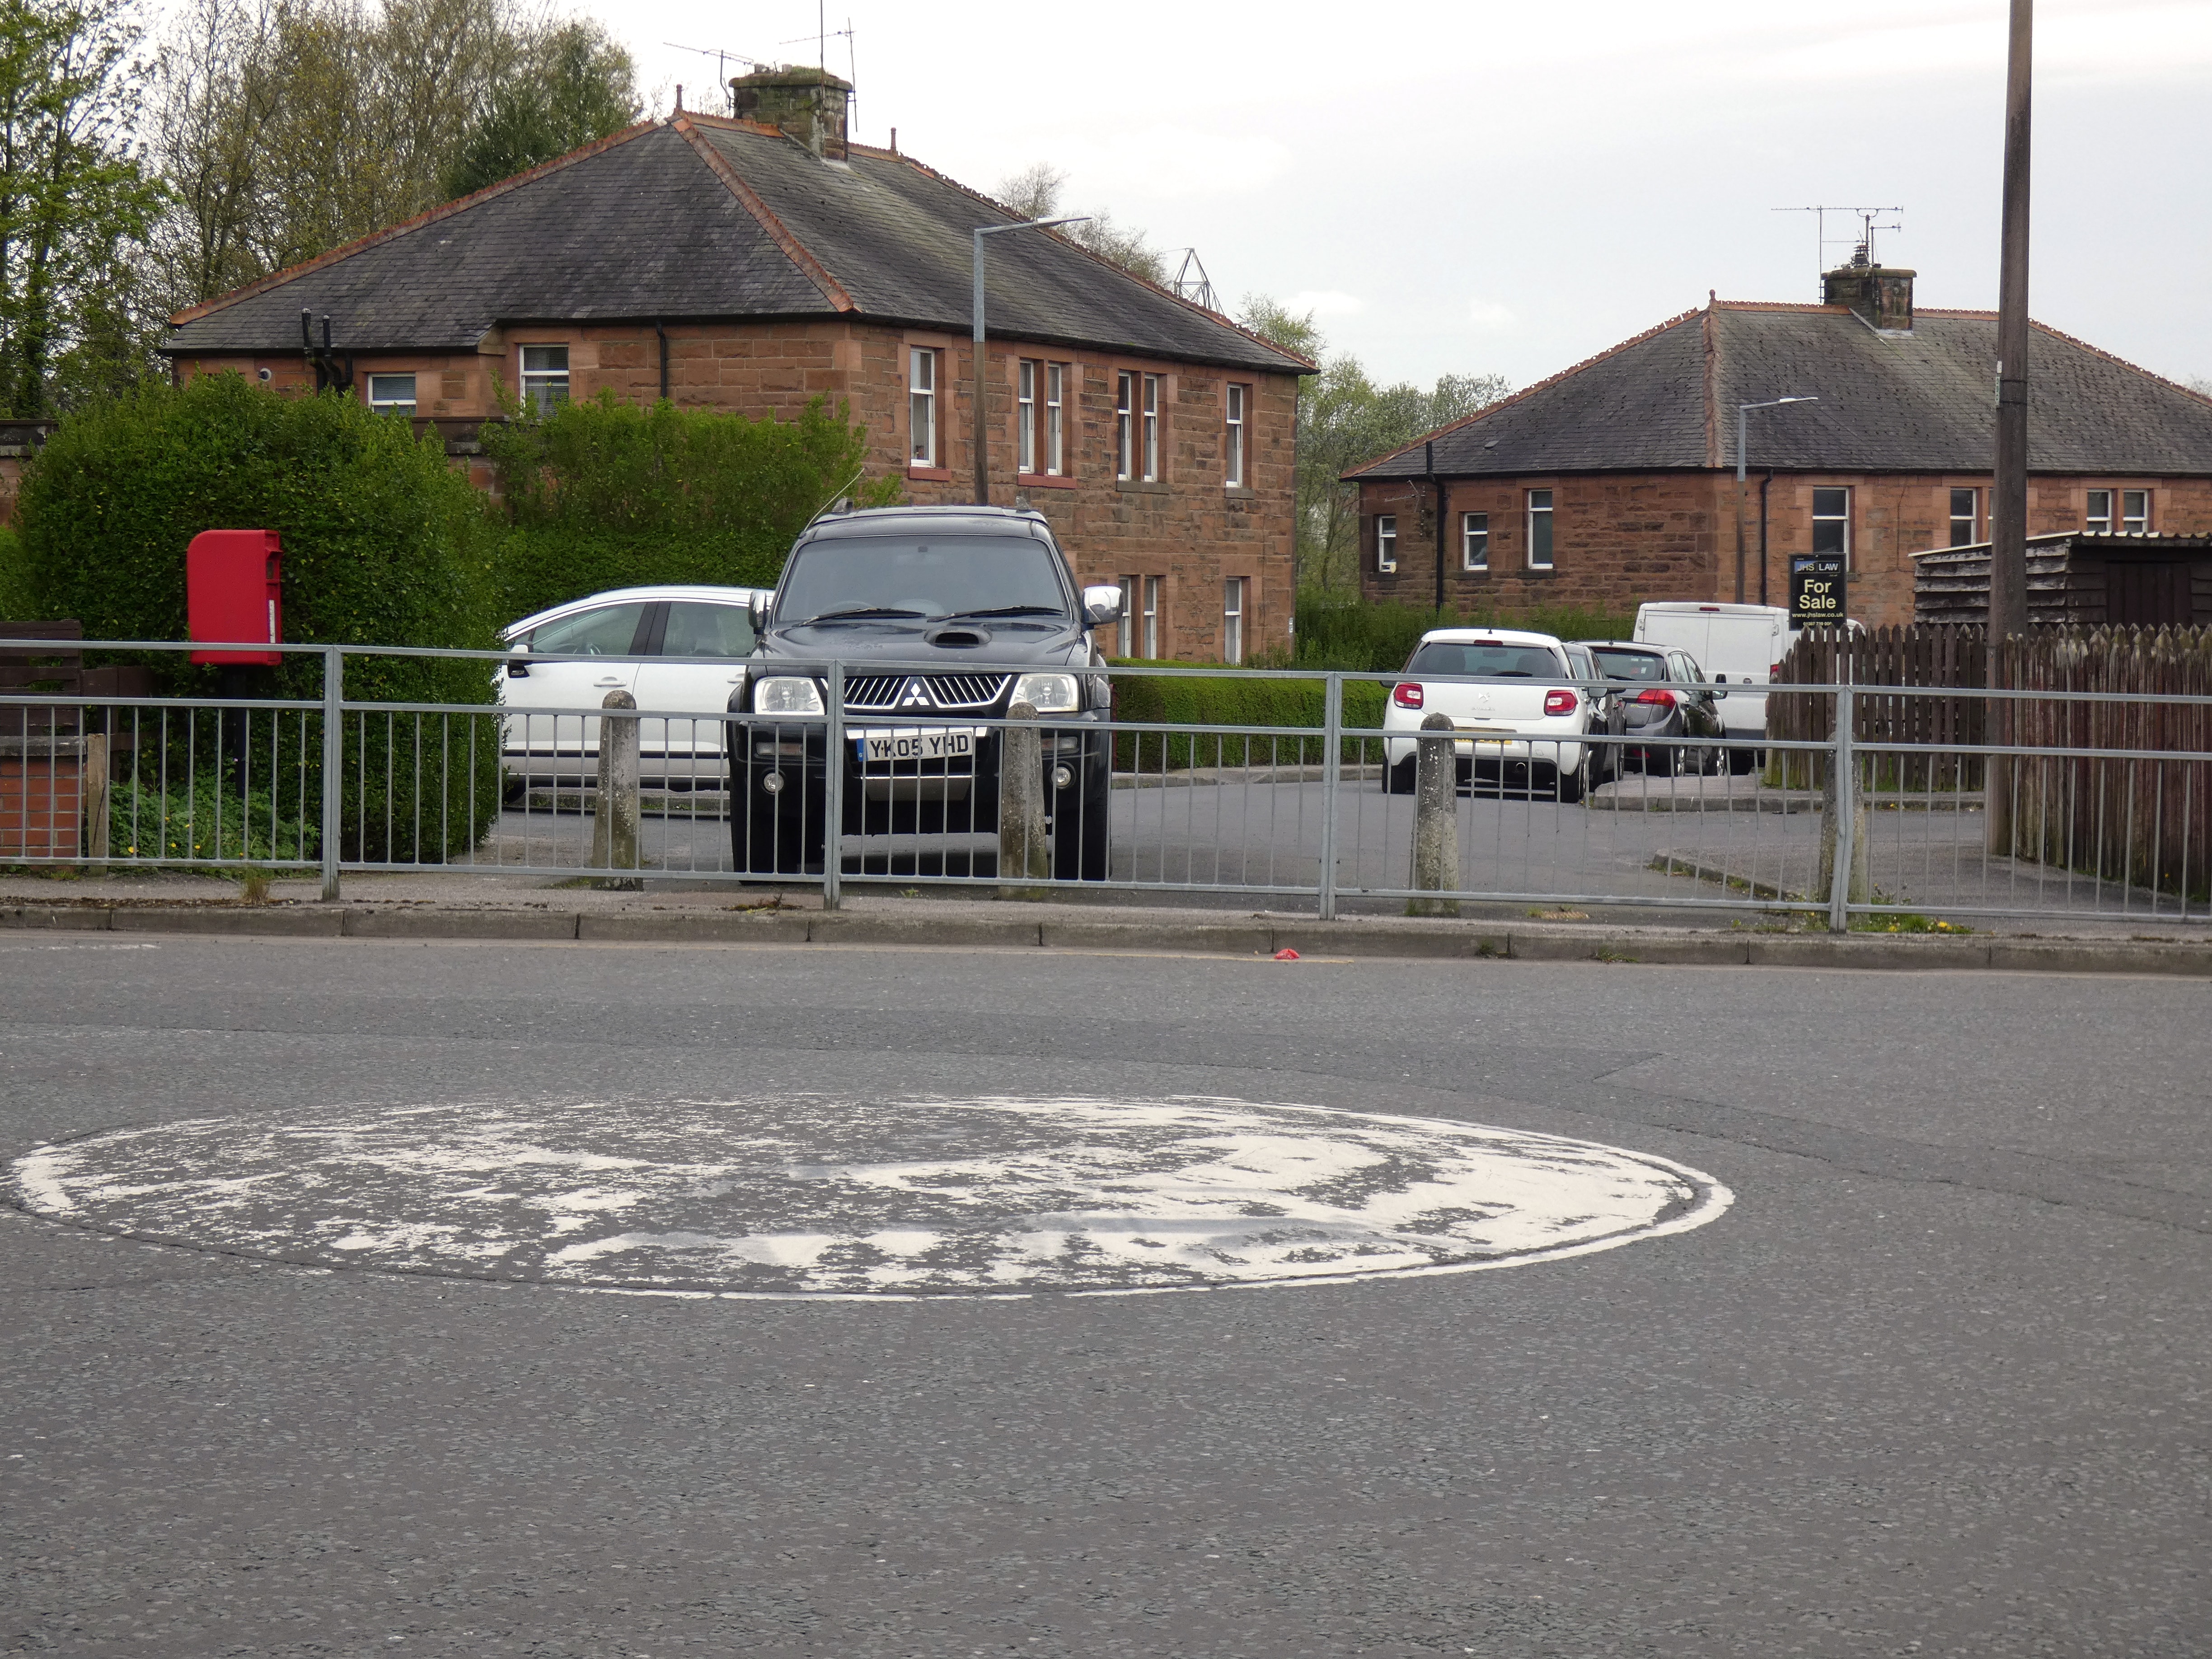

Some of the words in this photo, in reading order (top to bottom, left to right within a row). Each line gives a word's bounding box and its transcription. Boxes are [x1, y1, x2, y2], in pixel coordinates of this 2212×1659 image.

[1804, 579, 1832, 593] For
[1799, 595, 1836, 609] Sale
[870, 738, 923, 758] YK05
[929, 735, 969, 755] YHD
